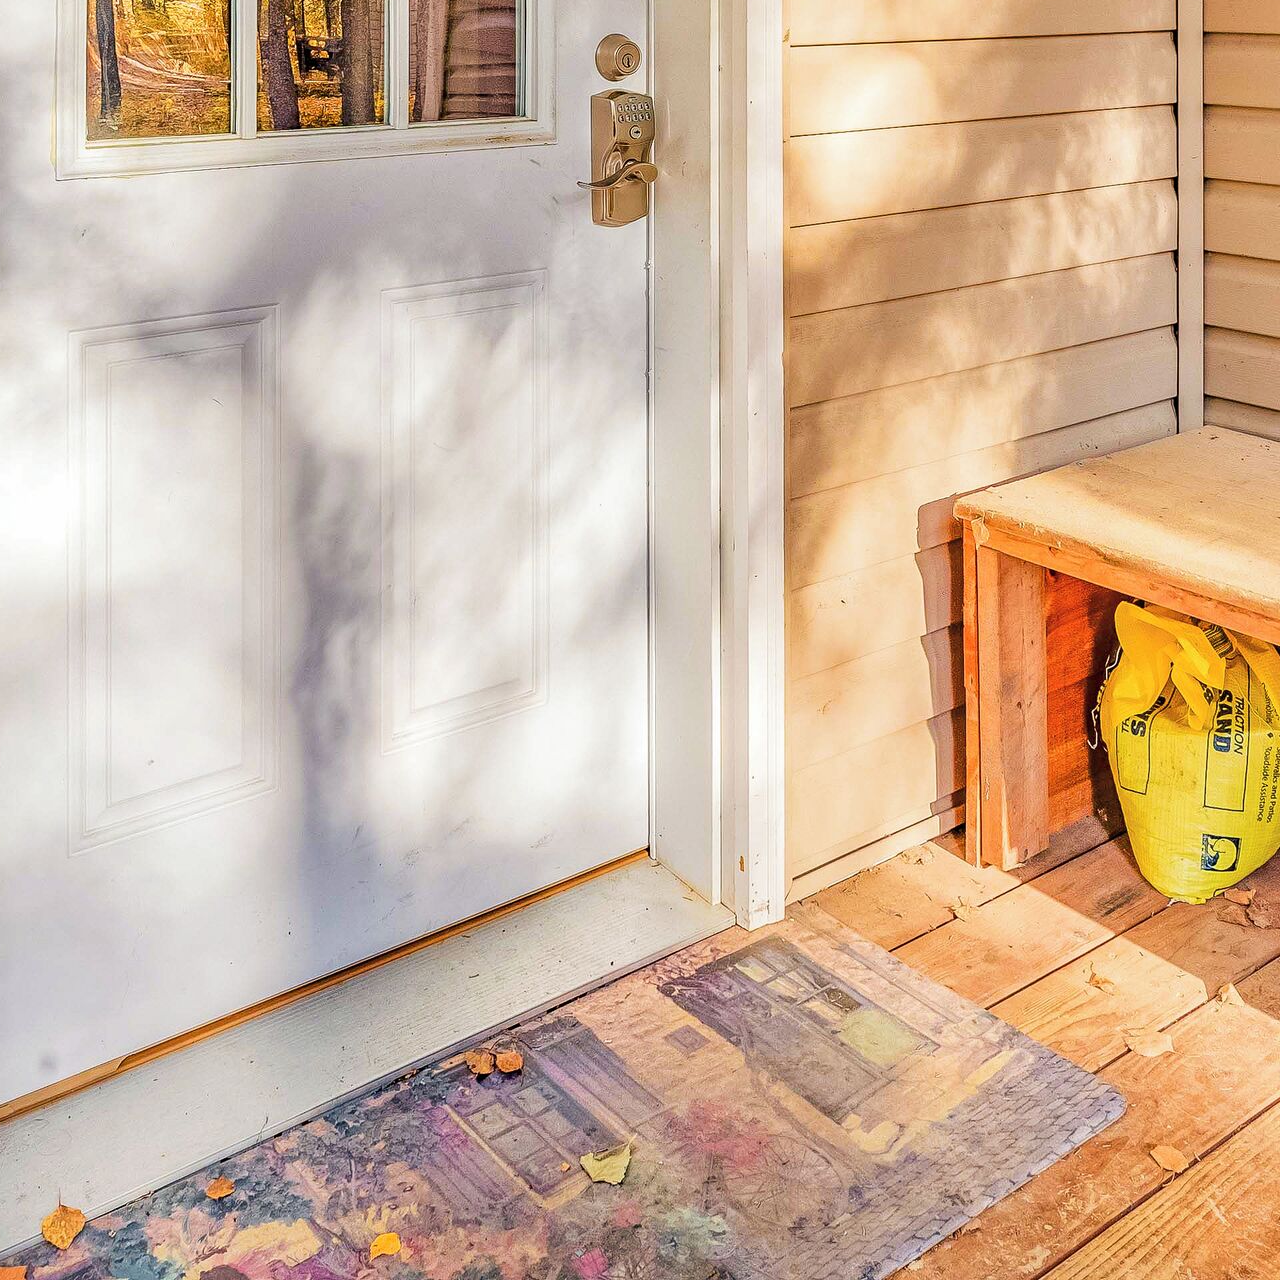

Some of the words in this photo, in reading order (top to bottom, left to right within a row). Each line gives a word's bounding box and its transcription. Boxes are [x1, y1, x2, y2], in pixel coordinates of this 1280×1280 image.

[1213, 689, 1233, 753] SAND
[1233, 696, 1245, 755] TRACTION
[1256, 782, 1269, 822] Assistance
[1270, 784, 1278, 799] and
